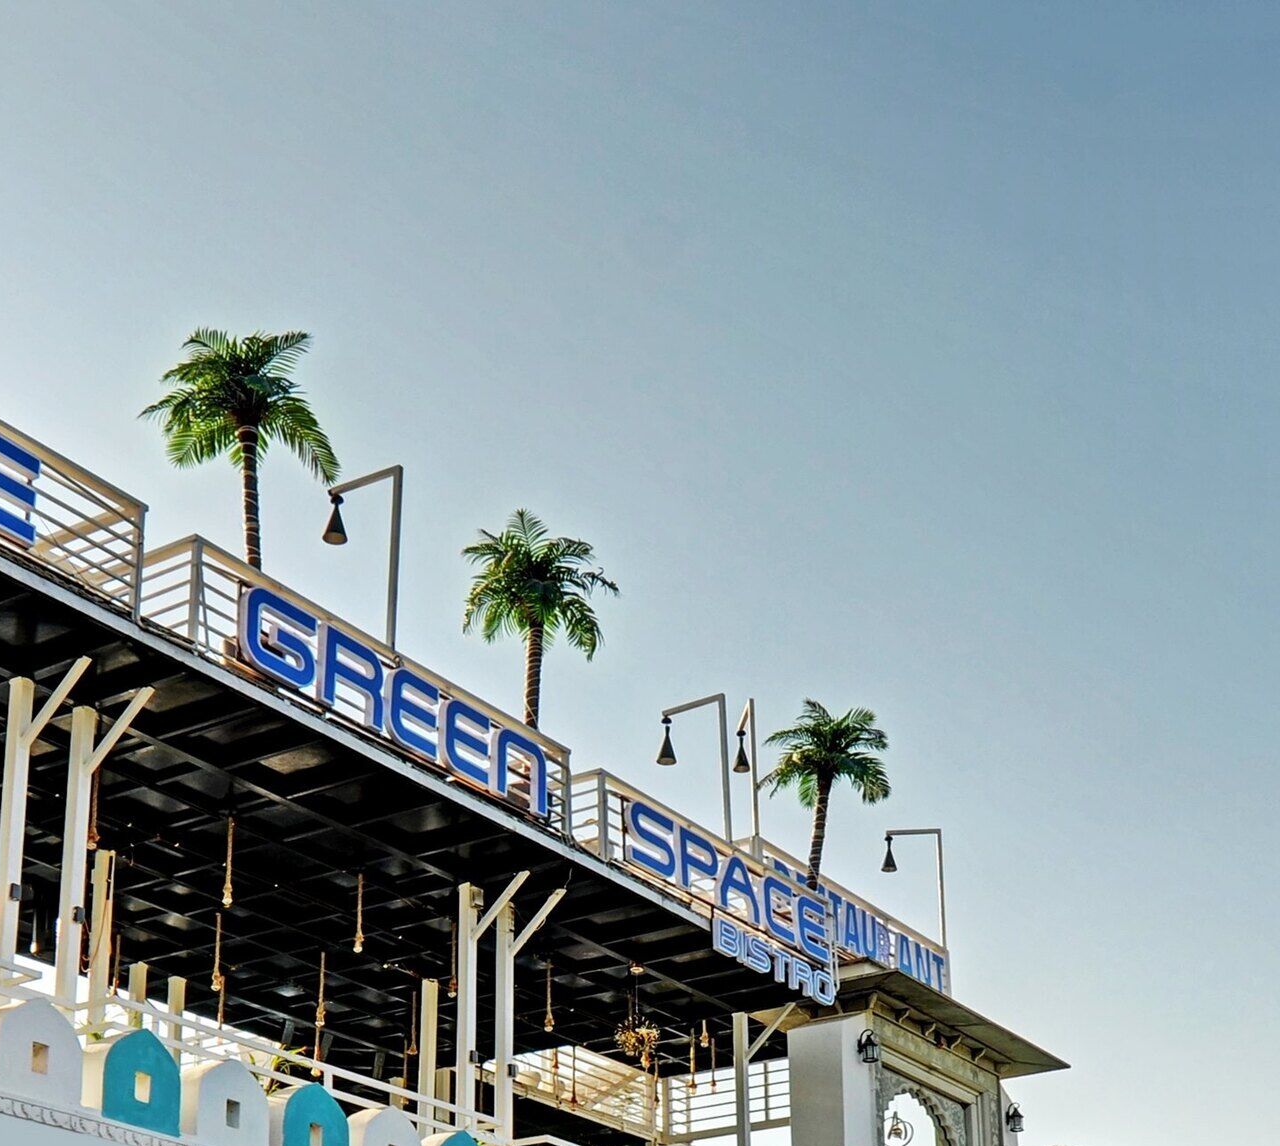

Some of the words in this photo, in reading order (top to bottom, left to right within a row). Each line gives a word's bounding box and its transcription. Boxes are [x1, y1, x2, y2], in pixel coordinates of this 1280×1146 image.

[239, 587, 550, 817] GREEN
[626, 800, 831, 963] SPACE
[715, 918, 836, 1006] BISTRO
[773, 857, 944, 993] TAURANT
